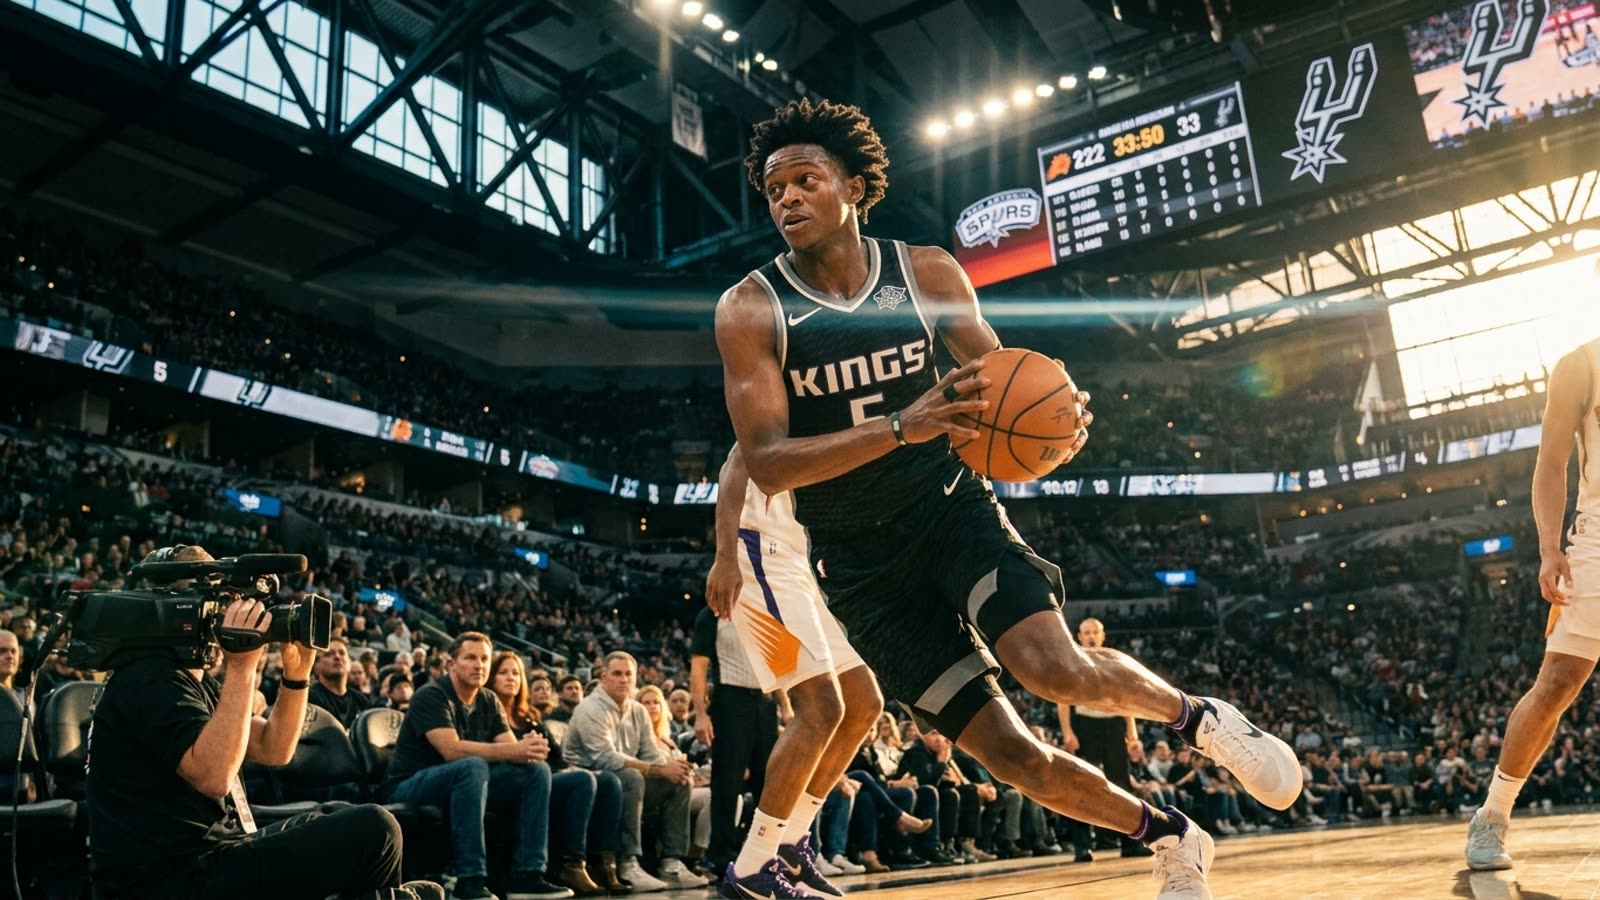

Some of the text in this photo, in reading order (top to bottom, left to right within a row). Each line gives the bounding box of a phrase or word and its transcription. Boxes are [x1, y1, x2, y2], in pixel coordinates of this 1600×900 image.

[1072, 143, 1106, 171] 222
[1111, 124, 1165, 157] 33:50
[1176, 112, 1201, 136] 33
[966, 203, 1032, 237] SPURS
[153, 360, 168, 383] 5
[789, 339, 927, 397] KINGS
